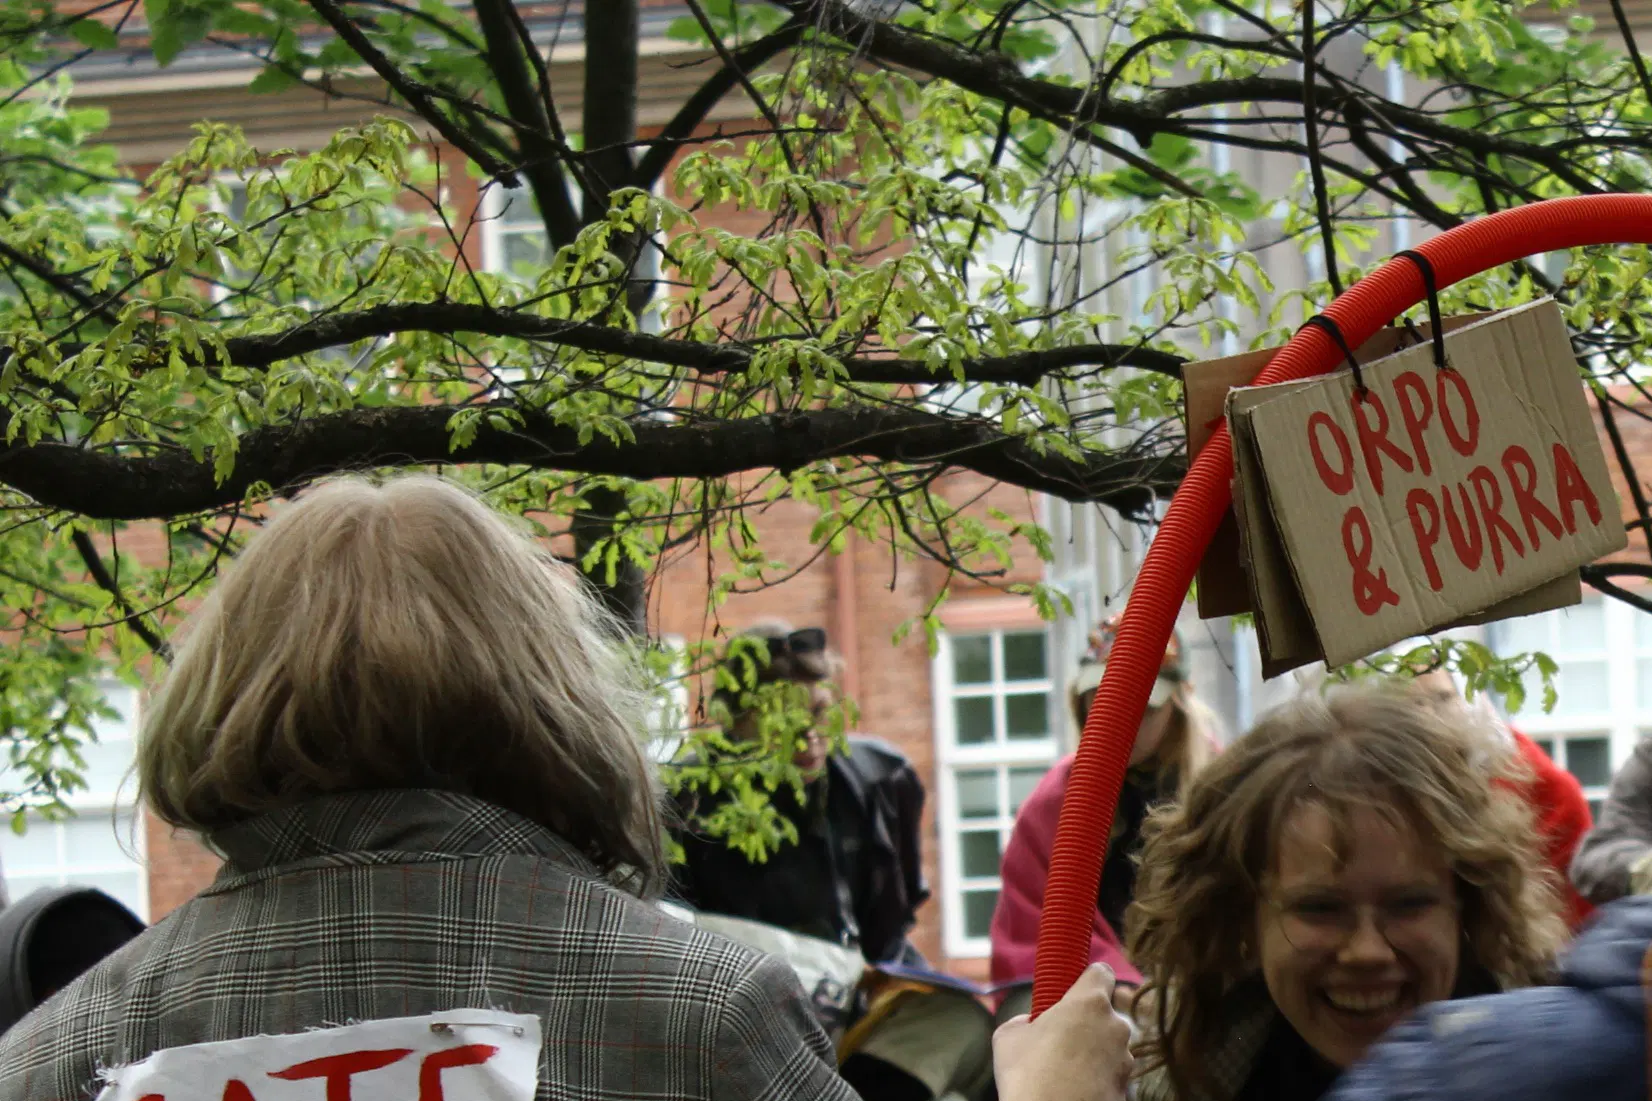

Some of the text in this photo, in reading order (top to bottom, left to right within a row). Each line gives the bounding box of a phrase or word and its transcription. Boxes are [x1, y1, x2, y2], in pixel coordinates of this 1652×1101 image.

[1305, 366, 1481, 497] ORPO
[1339, 441, 1603, 617] & PURRA
